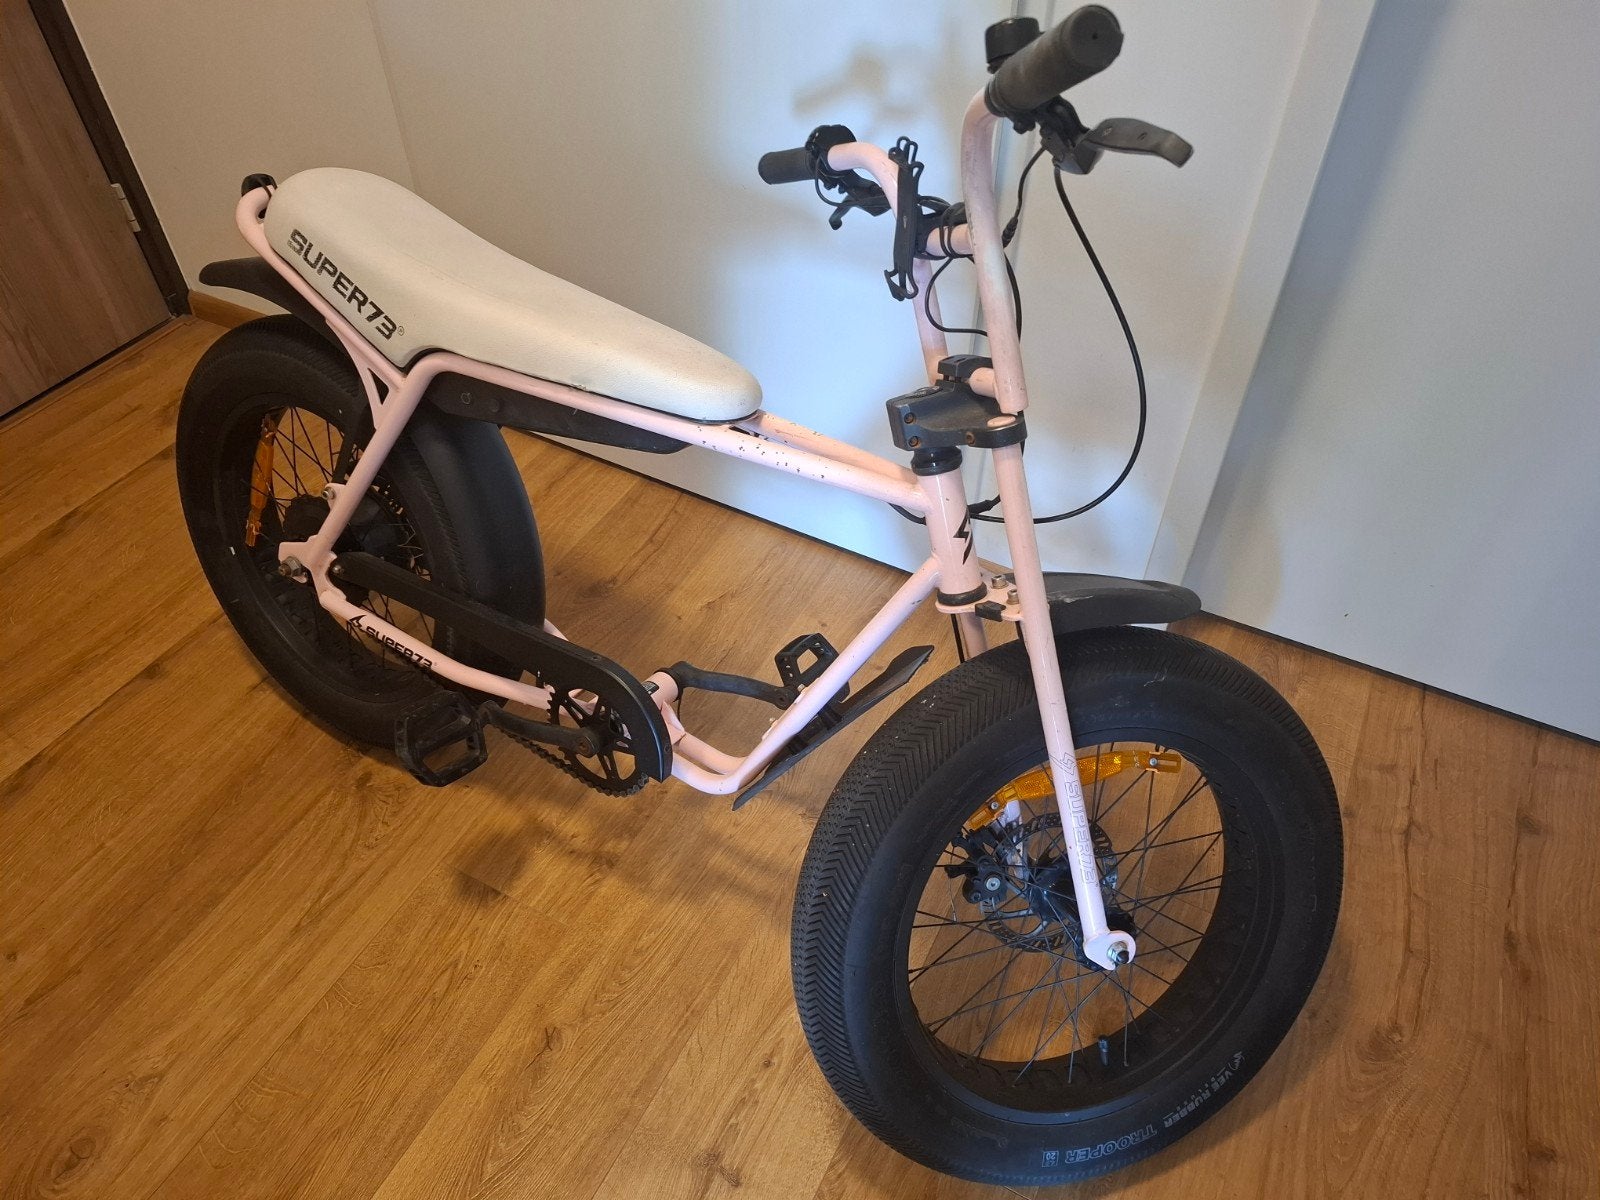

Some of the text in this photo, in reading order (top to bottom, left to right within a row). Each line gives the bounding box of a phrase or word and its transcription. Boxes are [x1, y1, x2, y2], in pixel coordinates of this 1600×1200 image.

[287, 229, 397, 340] SUPER73
[1065, 780, 1098, 885] SUPER73
[1065, 1124, 1157, 1164] TROOPER
[1164, 1089, 1211, 1128] RUBBER
